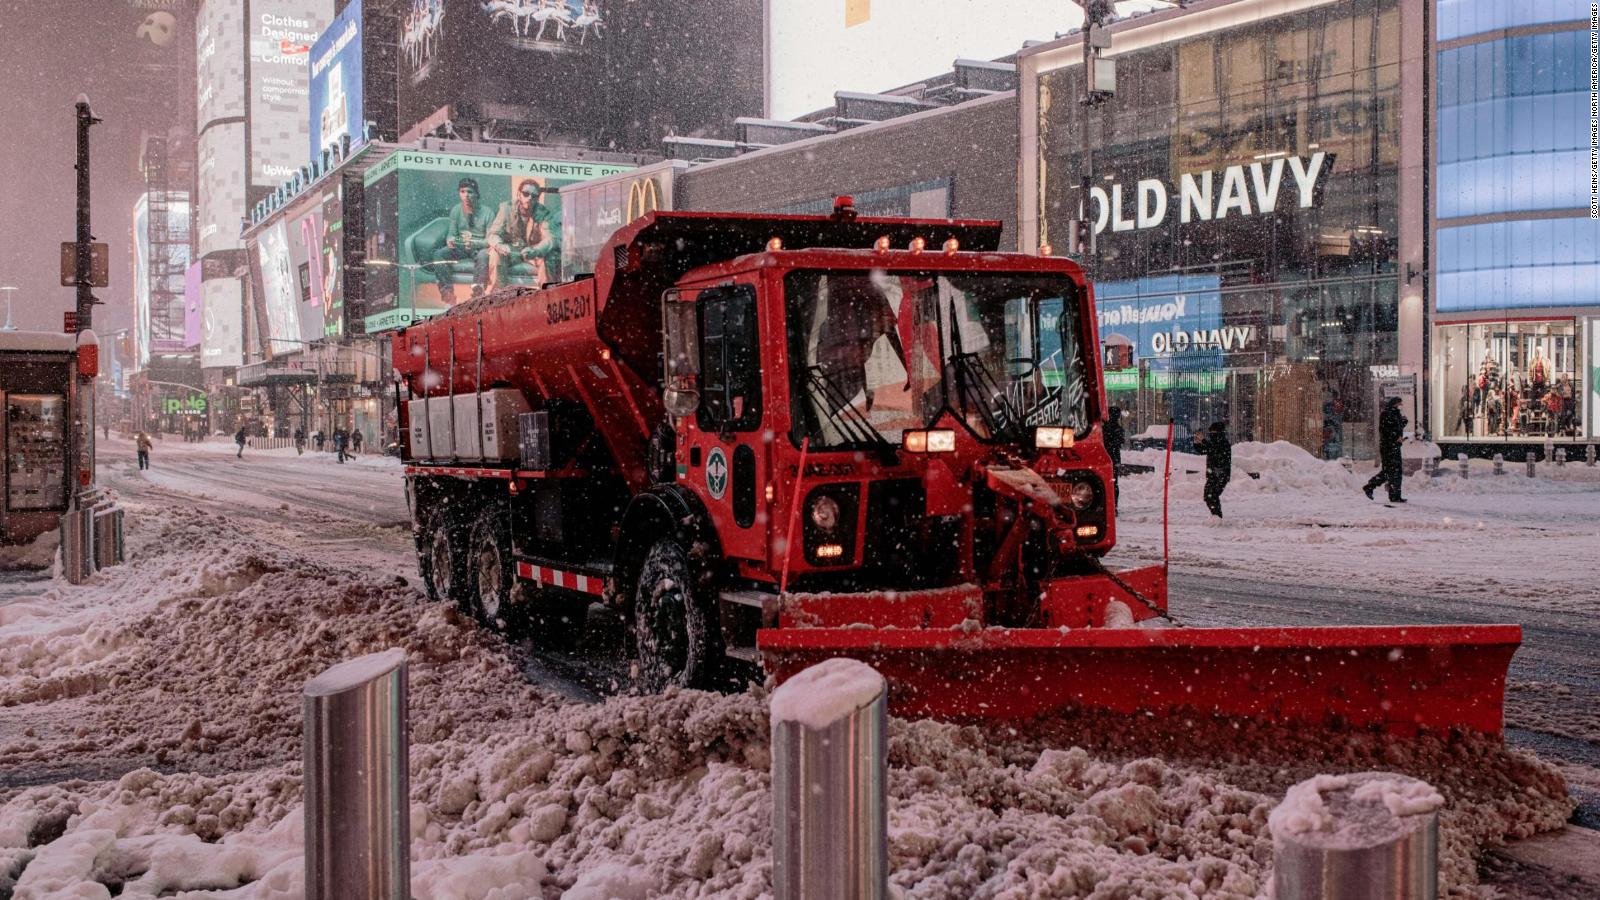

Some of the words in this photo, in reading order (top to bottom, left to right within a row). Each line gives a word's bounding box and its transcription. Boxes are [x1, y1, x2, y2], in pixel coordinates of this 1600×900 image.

[261, 13, 309, 29] Clothes
[262, 26, 318, 43] Designed
[262, 54, 309, 66] Comfor
[263, 165, 299, 177] UpWe
[403, 154, 443, 165] POST
[450, 158, 513, 170] MALONE
[529, 163, 593, 176] ARNETTE
[1080, 178, 1167, 234] OLD
[1180, 152, 1326, 224] NAVY
[1152, 331, 1188, 352] OLD
[1194, 327, 1250, 351] NAVY
